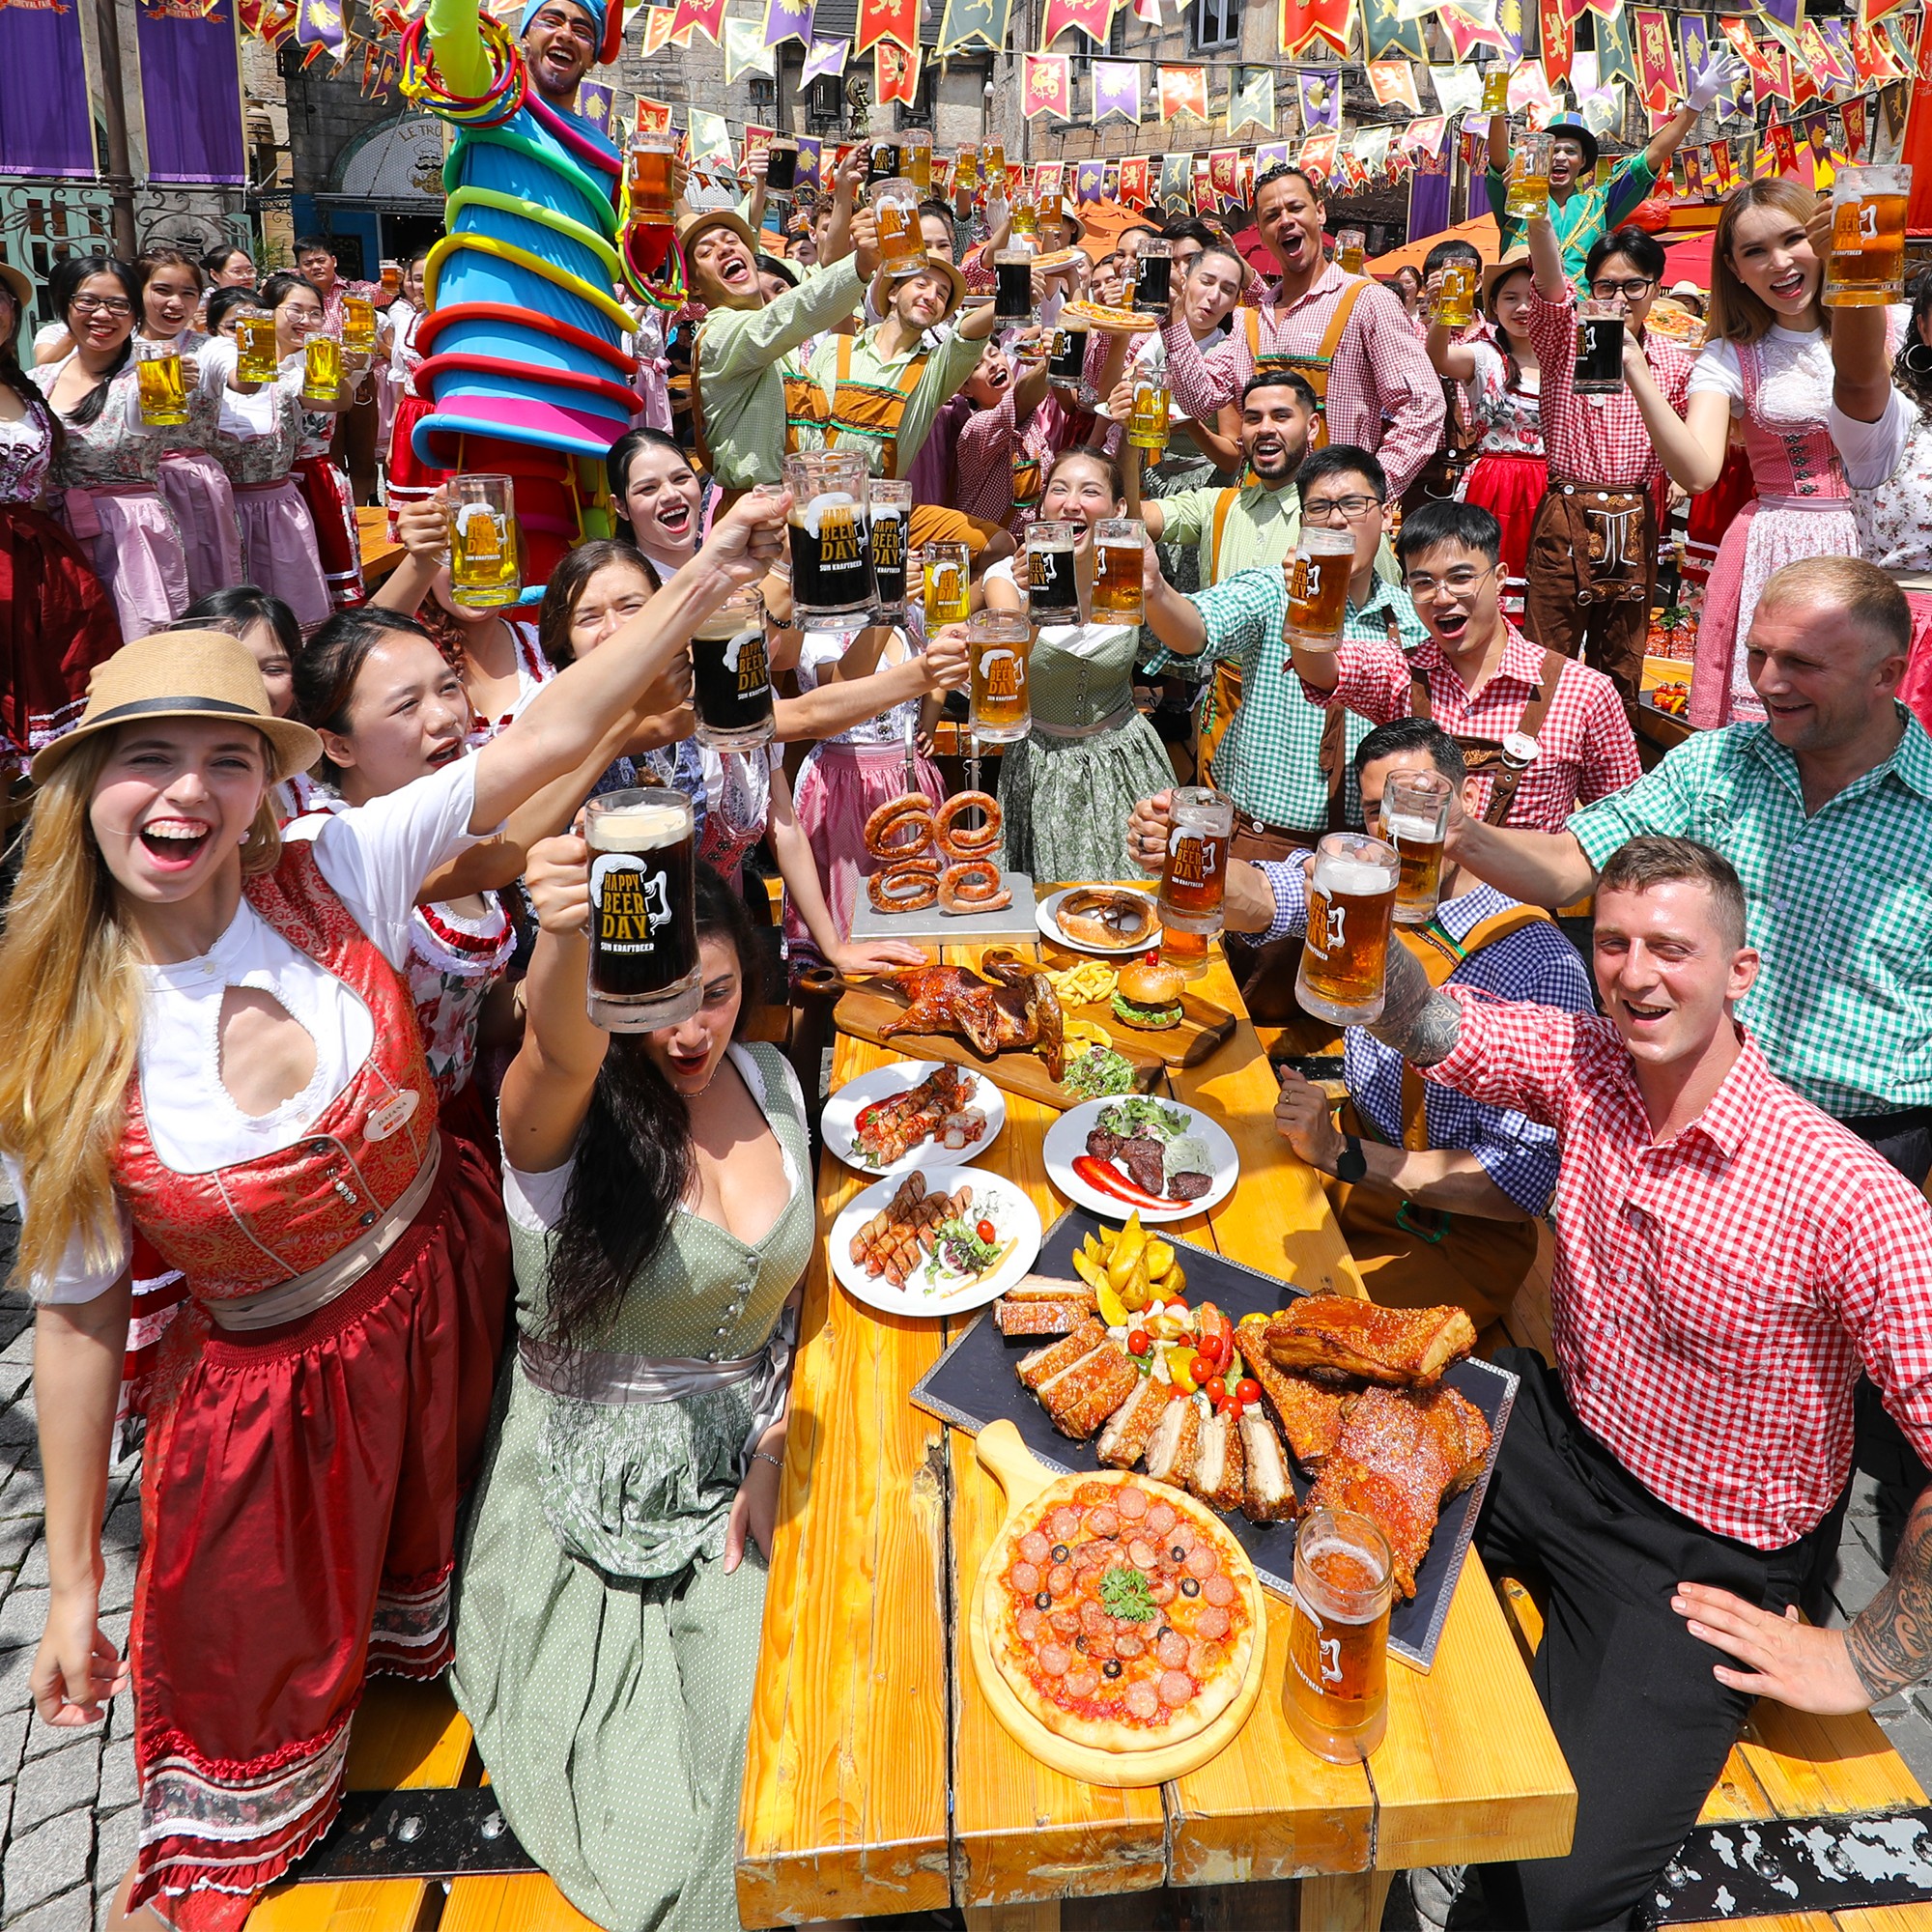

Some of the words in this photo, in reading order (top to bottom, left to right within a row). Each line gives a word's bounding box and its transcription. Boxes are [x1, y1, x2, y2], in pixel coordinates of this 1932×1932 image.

[398, 127, 417, 142] LE
[822, 506, 852, 524] HAPPY
[821, 522, 857, 543] BEER
[874, 520, 897, 533] HAPPY
[873, 532, 899, 549] BEER
[819, 539, 861, 562] DAY
[873, 548, 899, 565] DAY
[819, 562, 832, 572] SUN
[832, 559, 863, 571] KRAFTBEER
[739, 650, 765, 672] BEER
[991, 659, 1012, 670] HAPPY
[738, 668, 766, 692] DAY
[989, 668, 1014, 683] BEER
[988, 680, 1015, 696] DAY
[1179, 838, 1201, 851] HAPPY
[1177, 849, 1202, 866] BEER
[1174, 861, 1202, 879] DAY
[603, 873, 640, 893] HAPPY
[1179, 878, 1204, 888] KRAFTBEER
[603, 891, 647, 915] BEER
[601, 914, 648, 939] DAY
[600, 942, 612, 952] SUN
[612, 943, 655, 952] KRAFTBEER
[378, 1101, 408, 1126] DAIANA
